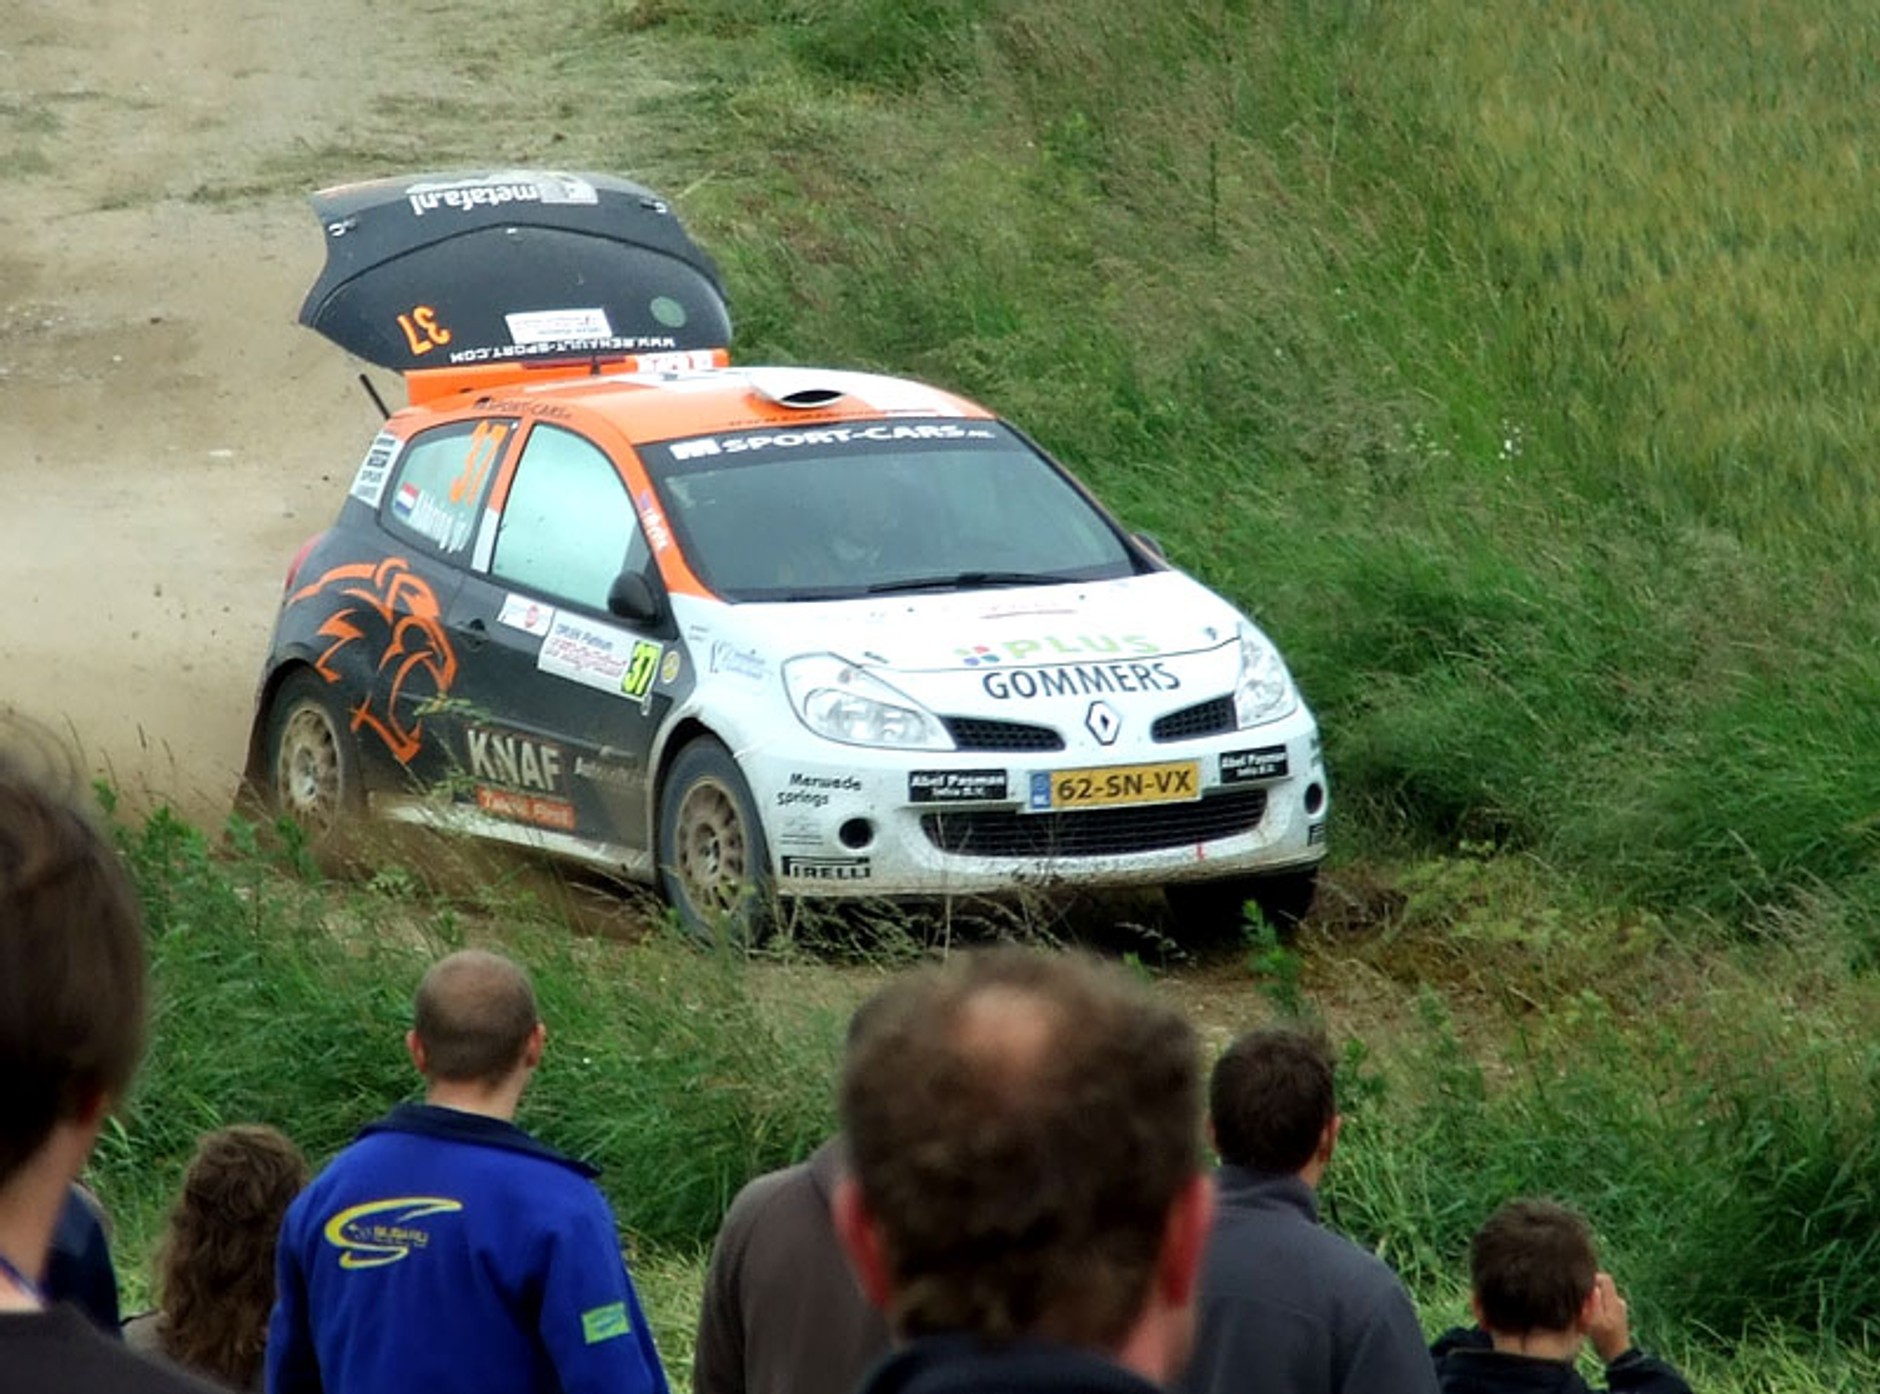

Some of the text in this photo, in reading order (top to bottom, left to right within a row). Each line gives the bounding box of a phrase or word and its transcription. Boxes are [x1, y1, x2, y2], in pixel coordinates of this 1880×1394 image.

[409, 183, 541, 216] metafa.nl
[397, 304, 453, 356] 37
[450, 419, 511, 507] 37
[1002, 634, 1162, 660] PLUS
[622, 641, 660, 697] 37
[982, 661, 1182, 700] GOMMERS
[467, 729, 562, 791] KNAF
[789, 773, 863, 792] Merwede
[1056, 770, 1194, 802] 62-SN-VX
[780, 855, 871, 879] PIRELLI
